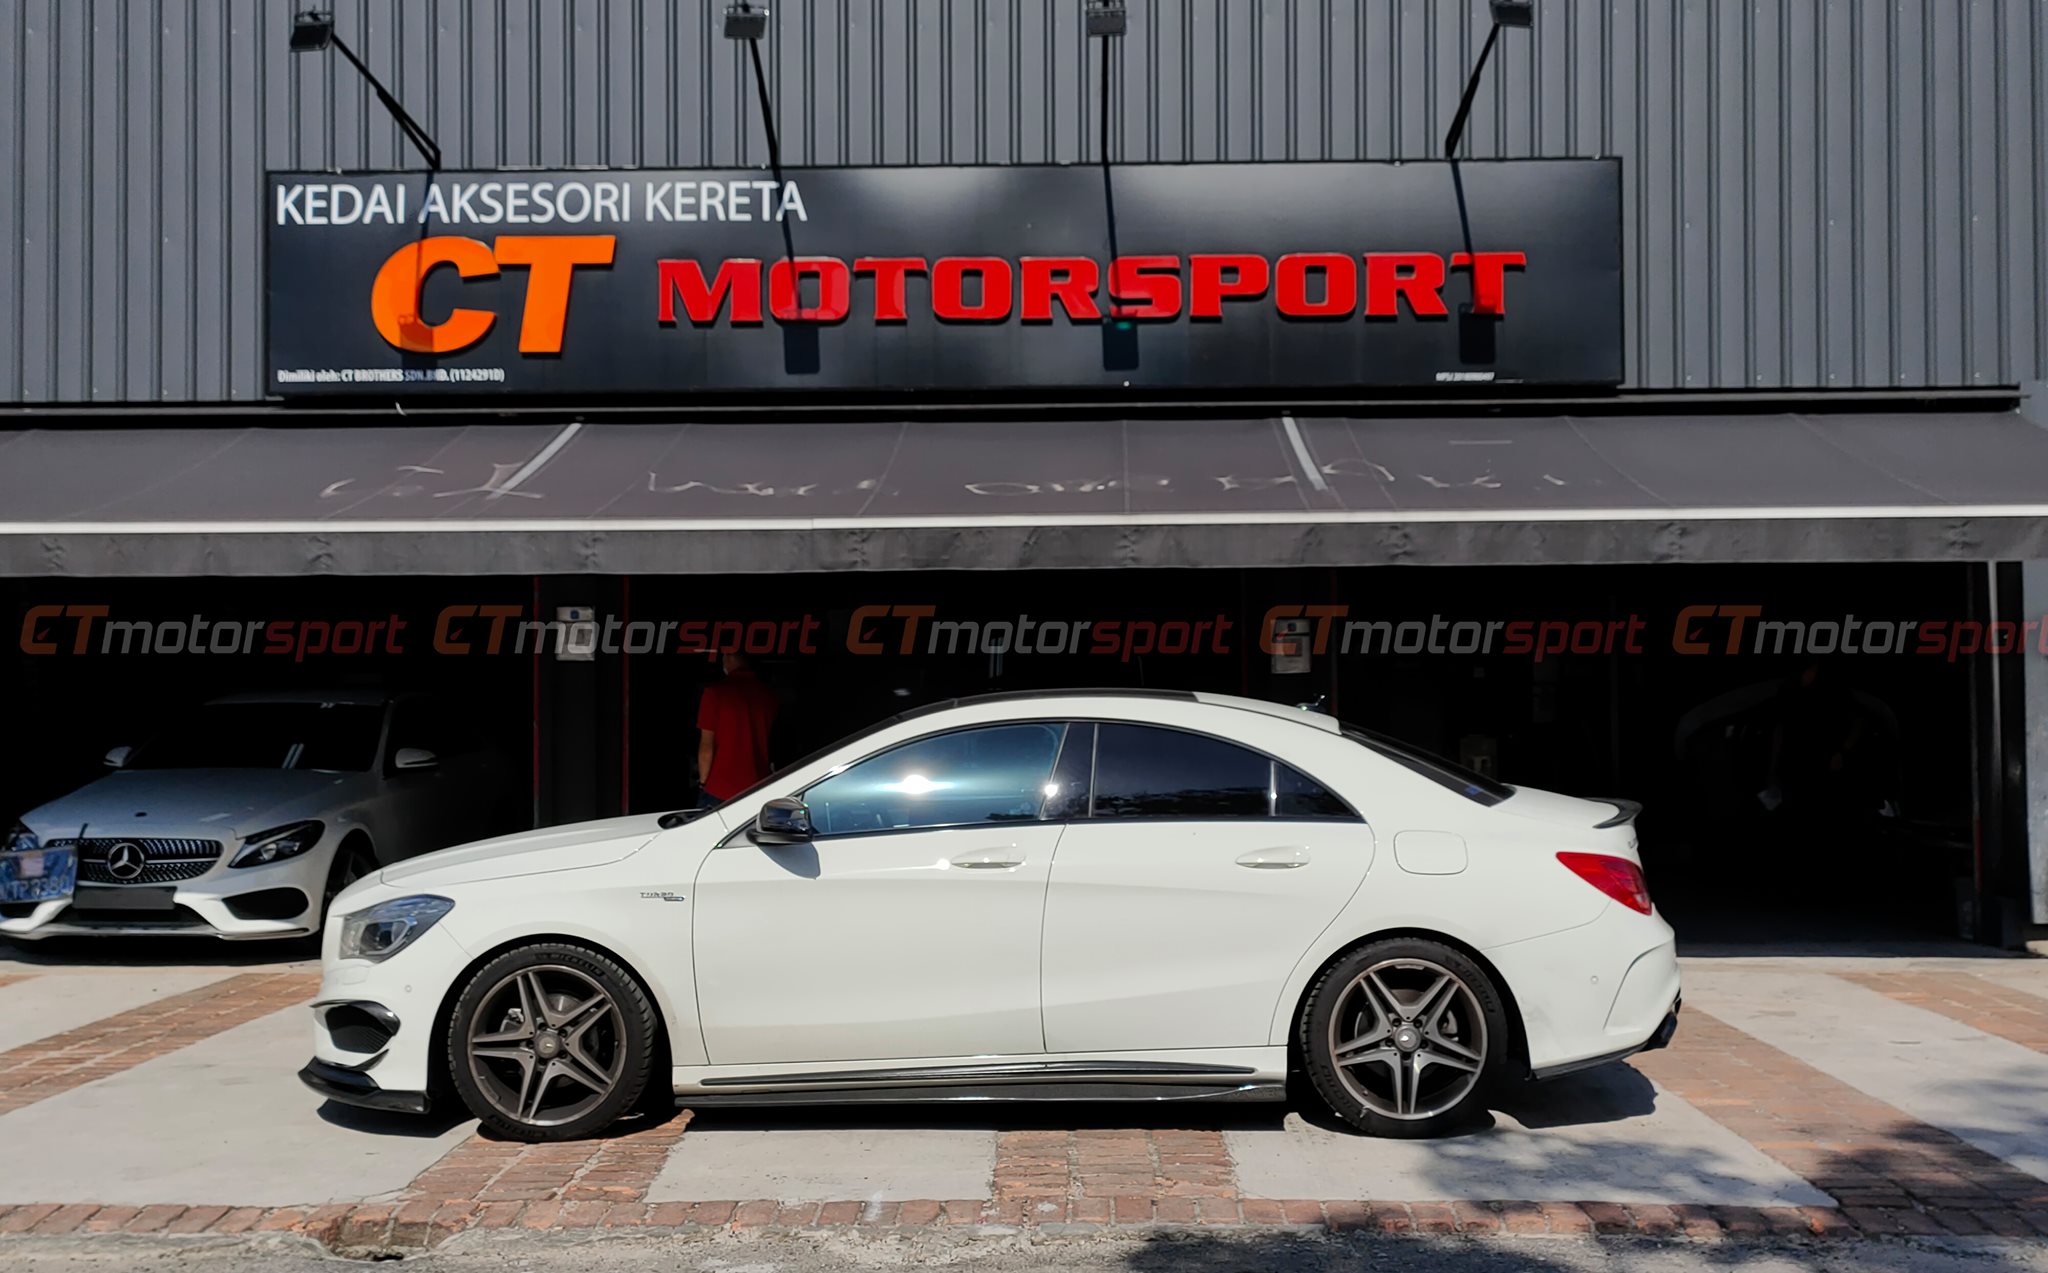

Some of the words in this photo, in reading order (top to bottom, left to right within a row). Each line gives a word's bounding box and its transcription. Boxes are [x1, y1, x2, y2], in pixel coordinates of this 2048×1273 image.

[276, 183, 406, 226] KEDAI
[418, 181, 631, 225] AKSESORI
[645, 180, 808, 224] KERETA
[371, 235, 616, 354] CT
[657, 252, 1527, 325] MOTORSPORT
[277, 369, 315, 382] Dimiliki
[341, 369, 354, 382] CT
[354, 369, 404, 382] BROTHERS
